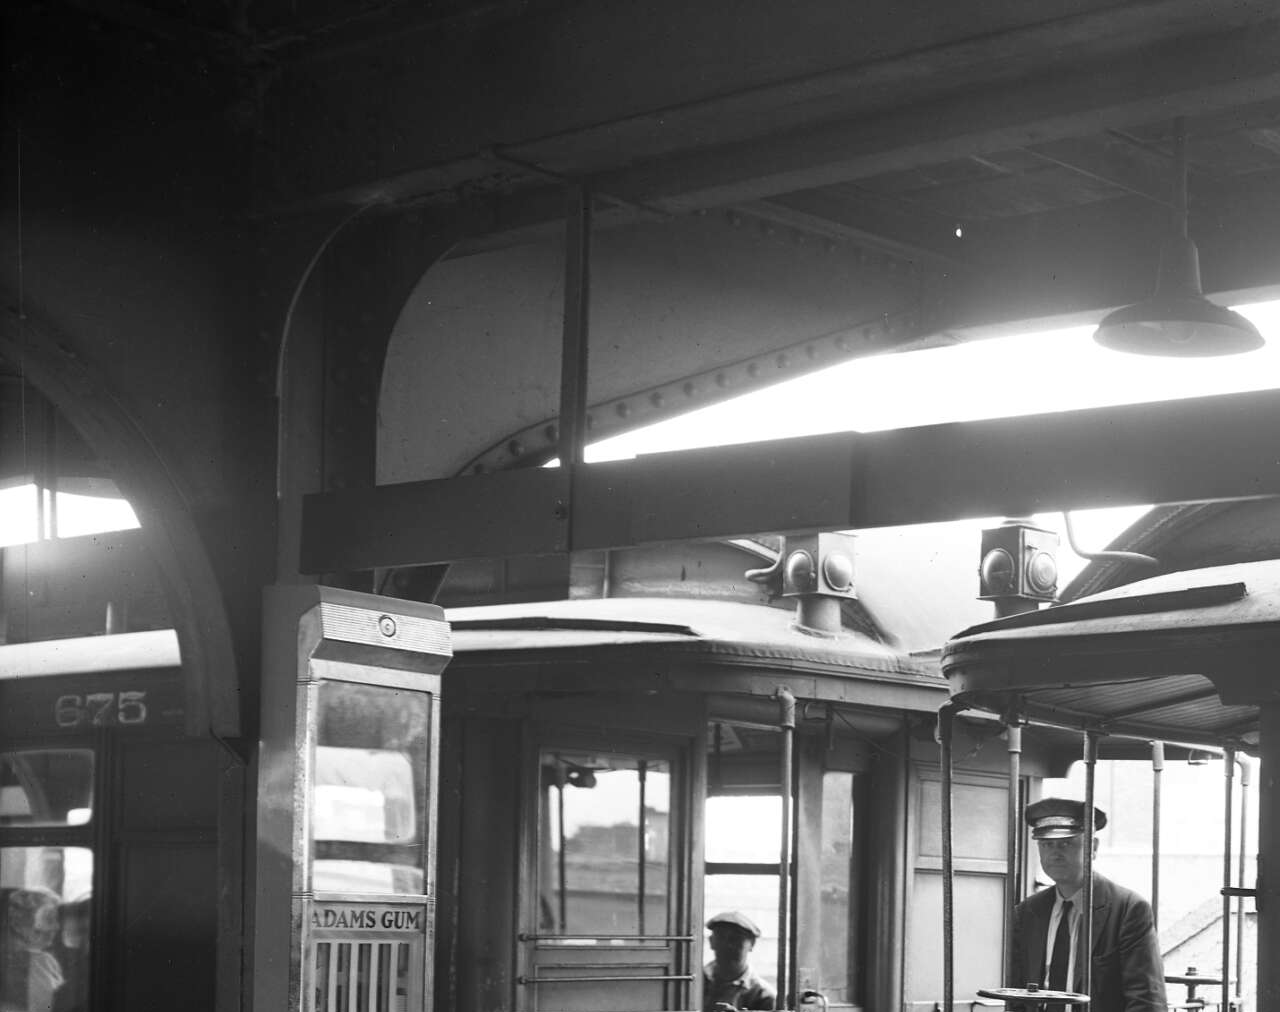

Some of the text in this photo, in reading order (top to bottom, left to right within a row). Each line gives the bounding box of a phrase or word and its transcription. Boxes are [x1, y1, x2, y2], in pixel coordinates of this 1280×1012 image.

[55, 690, 148, 726] 675
[312, 909, 421, 930] ADAMS GUM
